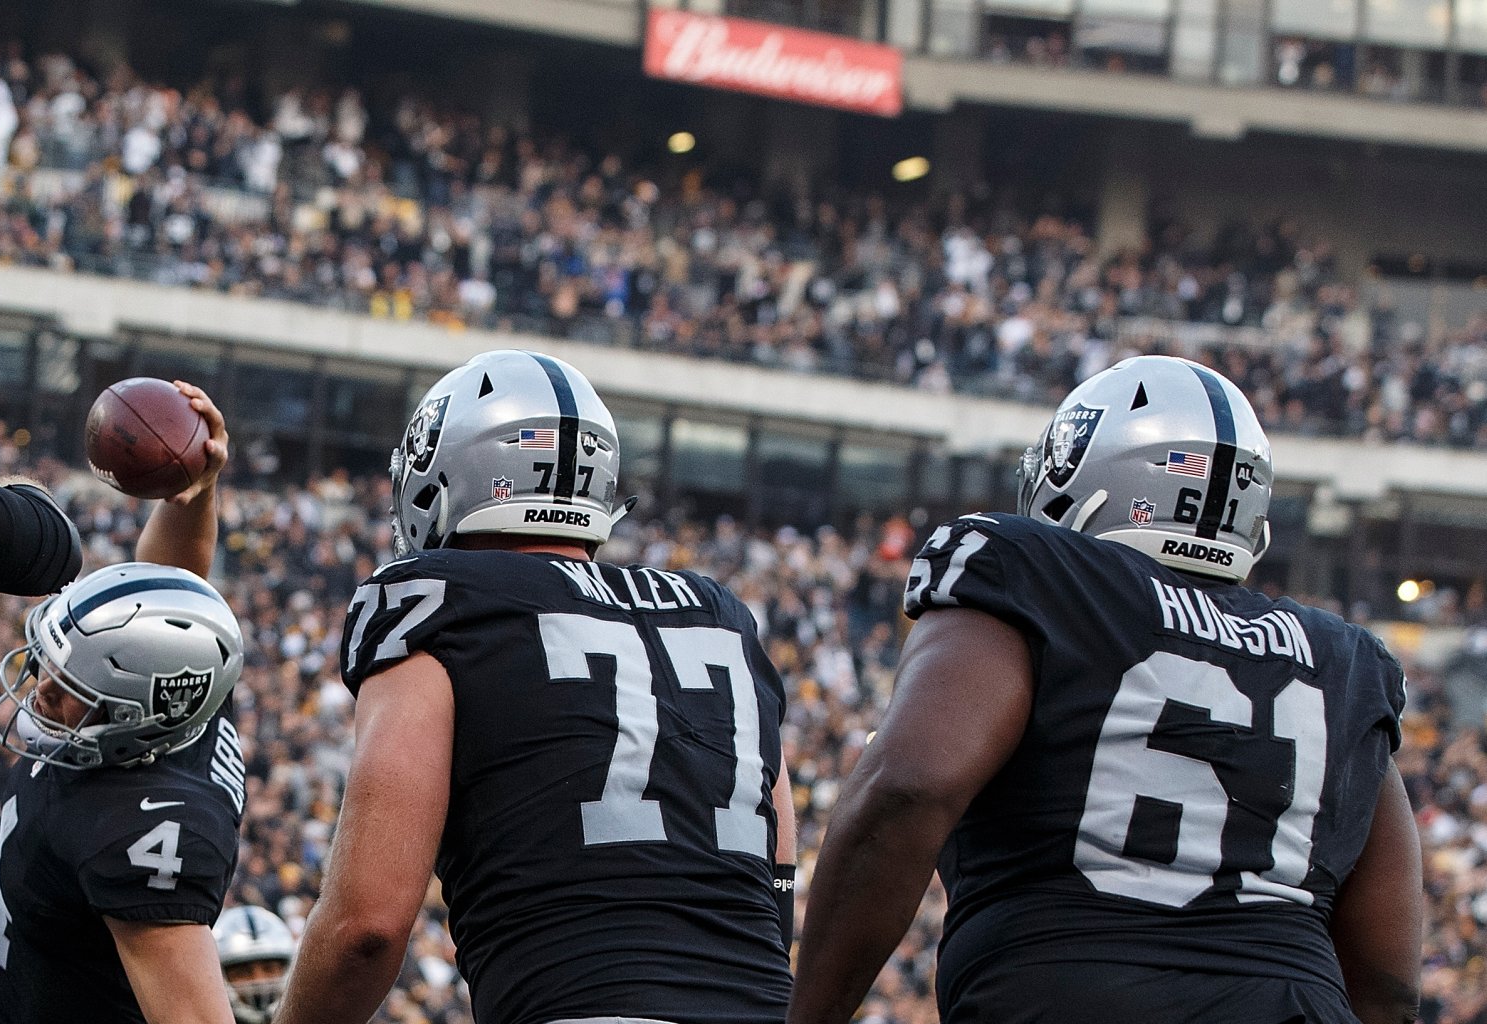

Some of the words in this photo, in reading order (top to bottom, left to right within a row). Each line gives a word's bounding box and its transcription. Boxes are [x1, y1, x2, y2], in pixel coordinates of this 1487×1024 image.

[655, 18, 892, 103] Budweiser
[583, 435, 597, 448] AL
[493, 487, 511, 499] NFL
[1237, 469, 1251, 481] AL
[523, 509, 591, 527] RAIDERS
[1131, 510, 1153, 525] NFL
[903, 524, 991, 613] 61
[1161, 539, 1235, 567] RAIDERS
[346, 578, 447, 674] 77
[1151, 576, 1315, 669] HUDSON
[161, 674, 208, 688] RAIDERS
[537, 608, 769, 861] 77
[1072, 650, 1328, 909] 61
[125, 819, 184, 891] 4
